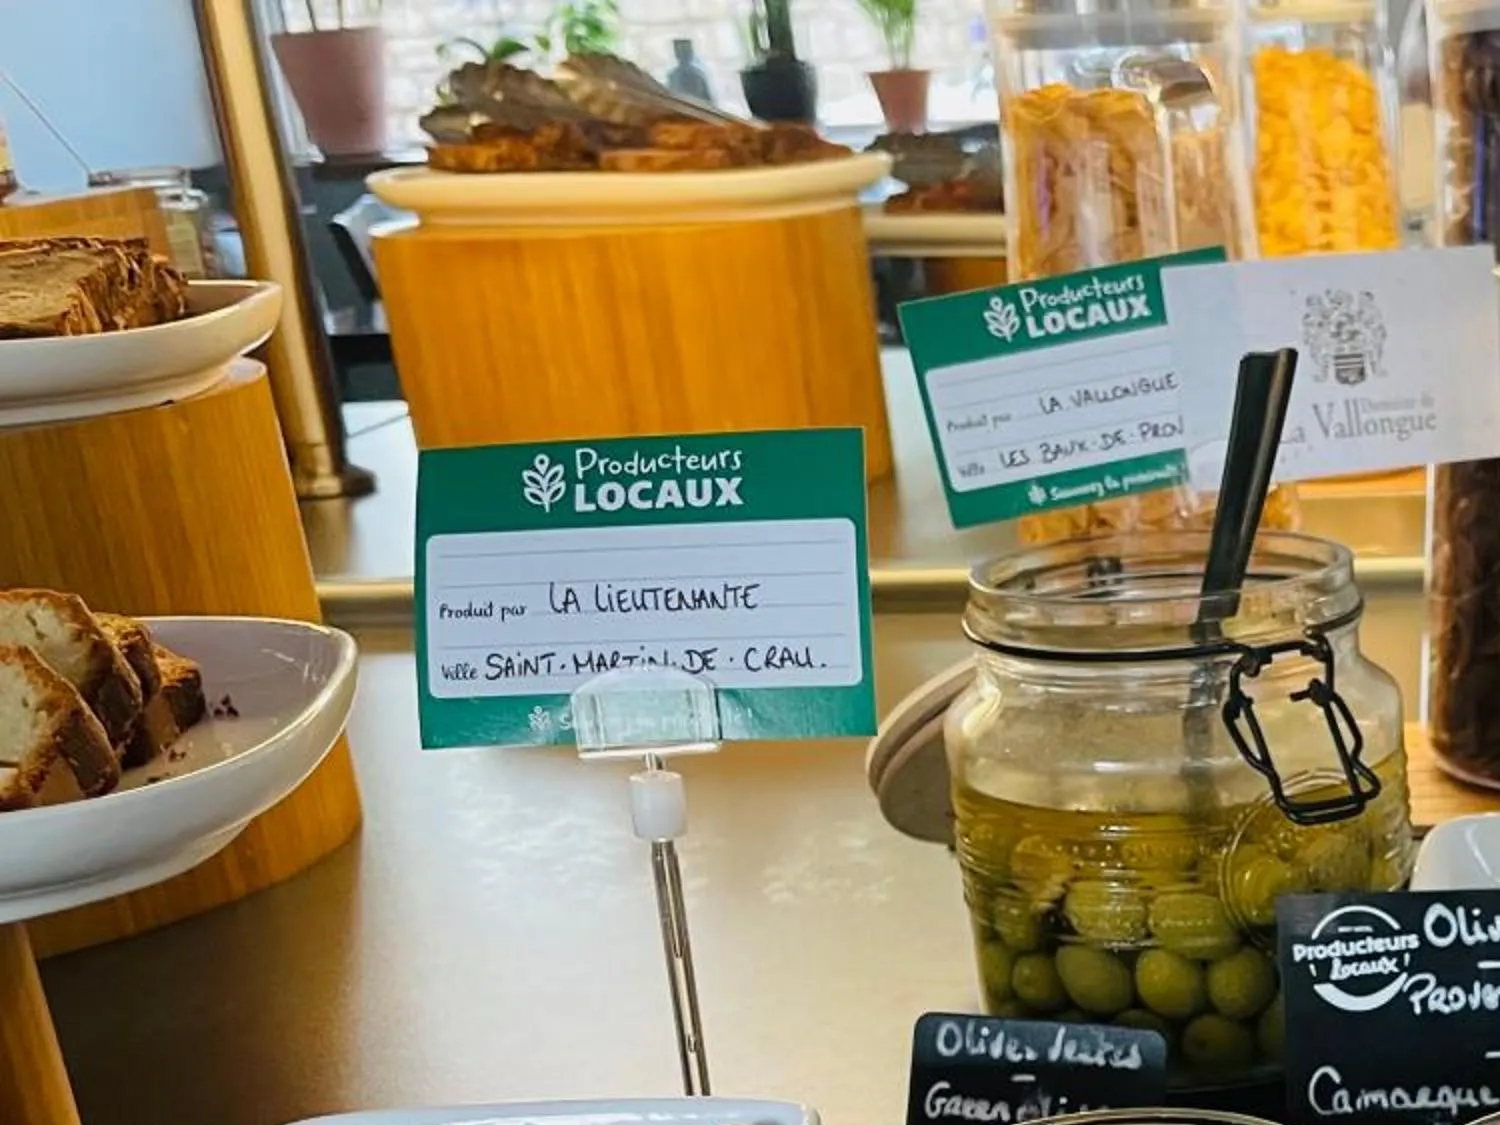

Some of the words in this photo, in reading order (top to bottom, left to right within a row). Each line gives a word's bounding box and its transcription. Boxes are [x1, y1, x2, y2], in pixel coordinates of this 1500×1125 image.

[1019, 274, 1145, 313] Producteurs
[1026, 294, 1152, 339] LOCAUX
[1312, 398, 1437, 442] Vallongue
[575, 445, 743, 479] Producteurs
[1000, 450, 1031, 468] LES
[574, 477, 744, 512] LOCAUX
[439, 602, 493, 620] Produit
[500, 604, 527, 622] par
[549, 582, 581, 614] LA
[441, 663, 478, 681] Ville
[1292, 934, 1420, 962] Producteurs
[924, 1081, 1011, 1122] Green
